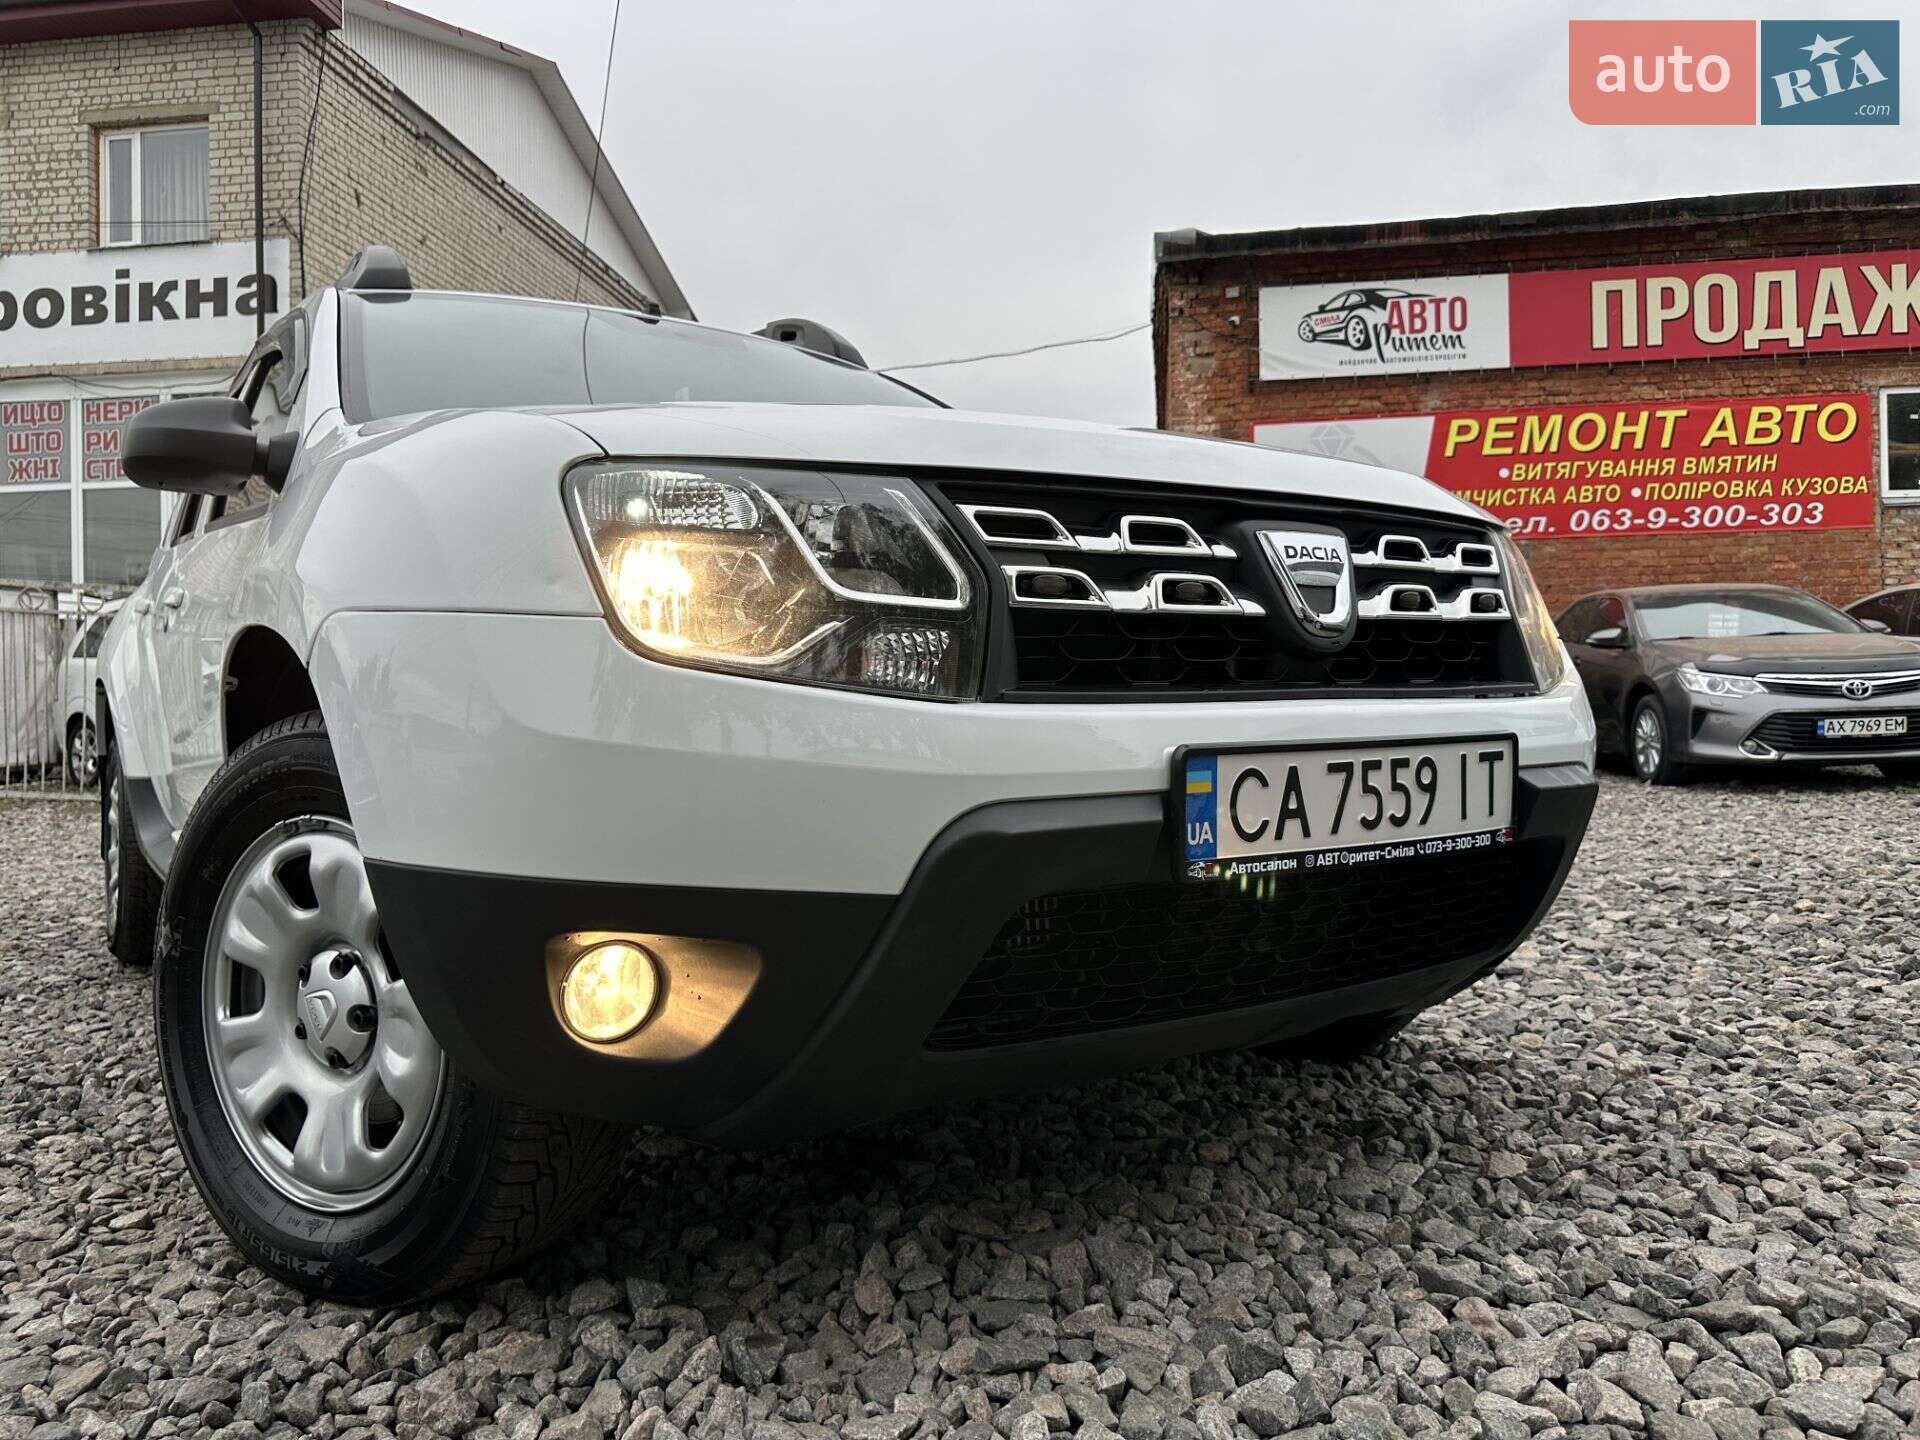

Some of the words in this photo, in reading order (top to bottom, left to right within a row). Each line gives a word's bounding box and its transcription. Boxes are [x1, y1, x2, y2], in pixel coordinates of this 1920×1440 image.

[1386, 296, 1468, 335] АВТО
[1591, 263, 1920, 350] ПРОДАЖ
[1445, 409, 1688, 457] РЕМОНТ
[1700, 402, 1858, 447] АВТО
[1511, 457, 1676, 481] ВИТЯГУВАННЯ
[1682, 454, 1778, 475] ВМЯТИН
[1563, 484, 1620, 504] АВТО
[1645, 479, 1773, 500] ПОЛІРОВКА
[1781, 476, 1868, 496] КУЗОВА
[1570, 502, 1824, 532] 063-9-300-303
[1284, 545, 1342, 562] DACIA
[1826, 720, 1846, 733] AX
[1850, 719, 1881, 732] 7969
[1885, 718, 1905, 731] EM
[1230, 765, 1311, 842] CA
[1327, 756, 1438, 835] 7559
[1460, 750, 1504, 820] IT
[1187, 822, 1214, 845] UA
[1230, 859, 1297, 875] Автосалон
[1425, 834, 1491, 854] 073-9-300-300
